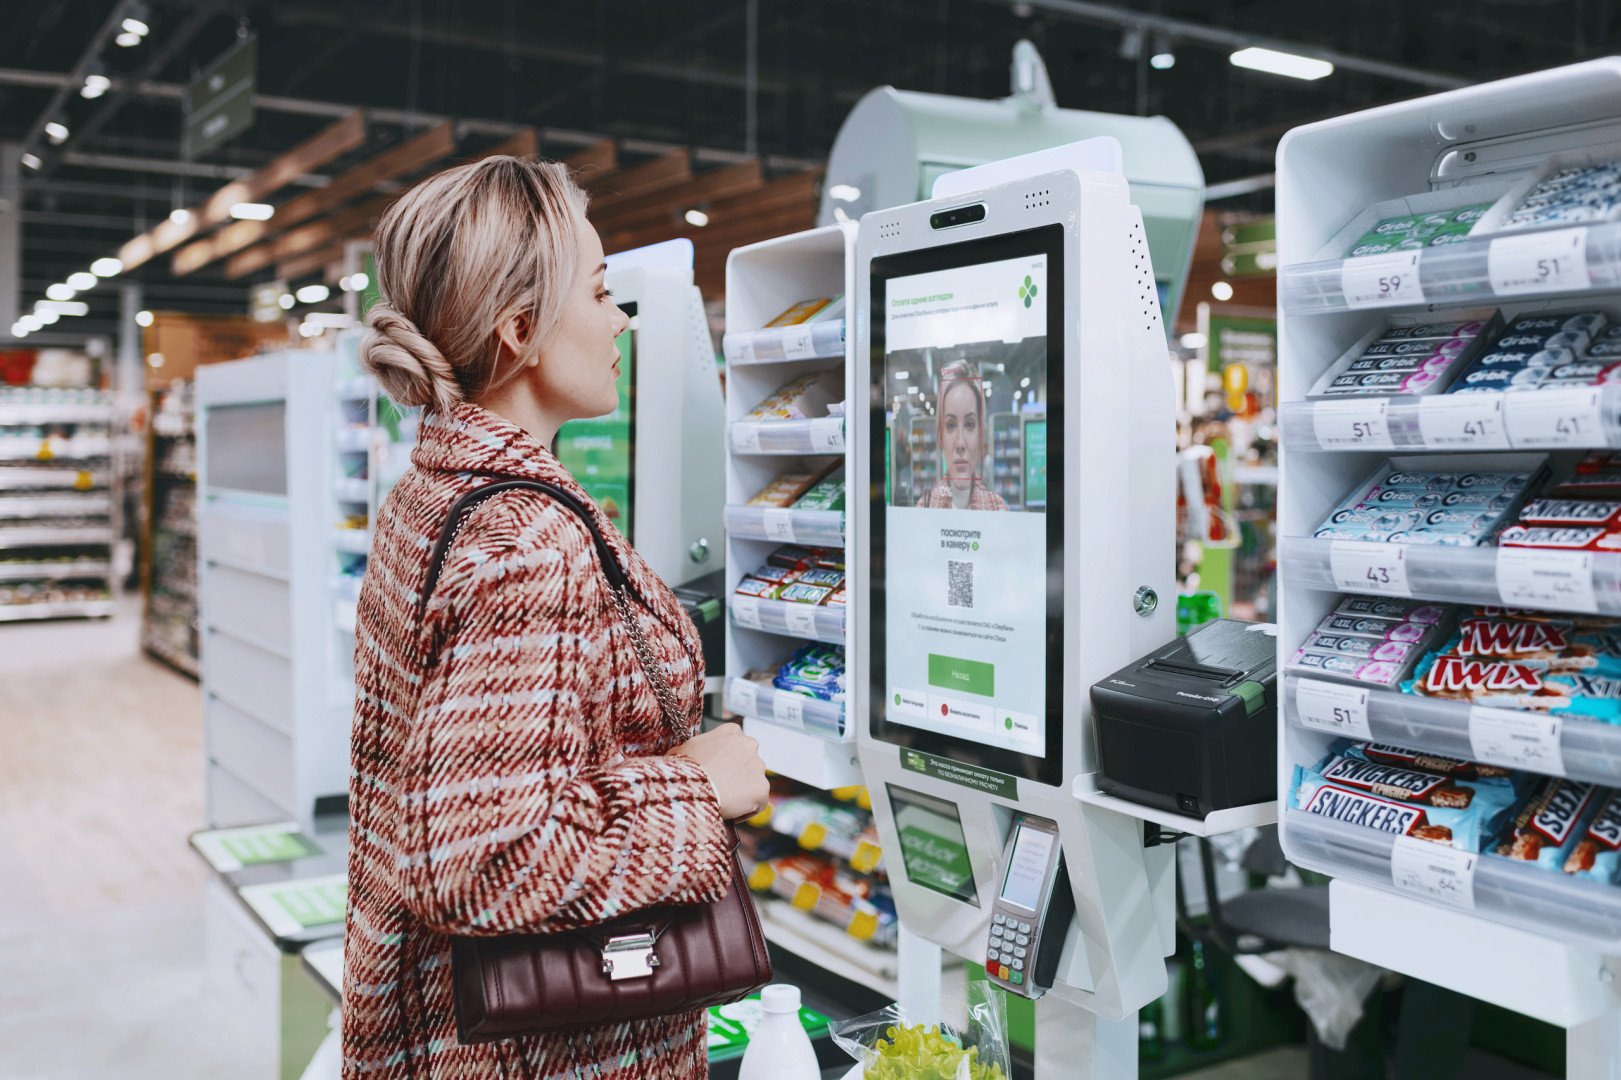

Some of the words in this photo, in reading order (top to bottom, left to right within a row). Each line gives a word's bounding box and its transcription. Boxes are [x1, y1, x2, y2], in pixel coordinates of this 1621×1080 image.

[1376, 220, 1415, 232] Orbit
[1537, 258, 1560, 277] 51
[1378, 275, 1401, 293] 59
[1415, 325, 1449, 336] Orbit
[1515, 319, 1558, 331] Orbit
[1396, 342, 1432, 353] Orbit
[1498, 335, 1543, 348] Orbit
[1379, 357, 1419, 369] Orbit
[1482, 352, 1527, 365] Orbit
[1361, 372, 1401, 385] Orbit
[1465, 369, 1511, 384] Orbit
[1352, 422, 1372, 437] 51
[1463, 420, 1486, 436] 41
[1389, 474, 1426, 484] Orbit
[1460, 475, 1499, 487] Orbit
[1381, 490, 1417, 501] Orbit
[1447, 492, 1486, 504] Orbit
[1431, 511, 1474, 523] Orbit
[940, 528, 981, 540] посмотрите
[946, 539, 970, 552] камеру
[1367, 567, 1390, 583] 43
[1375, 603, 1405, 613] Orbit
[1356, 620, 1387, 632] Orbit
[1458, 618, 1573, 656] TWIX
[1340, 638, 1371, 651] Orbit
[1325, 656, 1357, 669] Orbit
[952, 669, 970, 682] Назад
[1428, 655, 1546, 691] TWIX
[1334, 707, 1351, 724] 51
[1331, 758, 1438, 792] SNICKERS
[1312, 790, 1414, 836] SNICKERS
